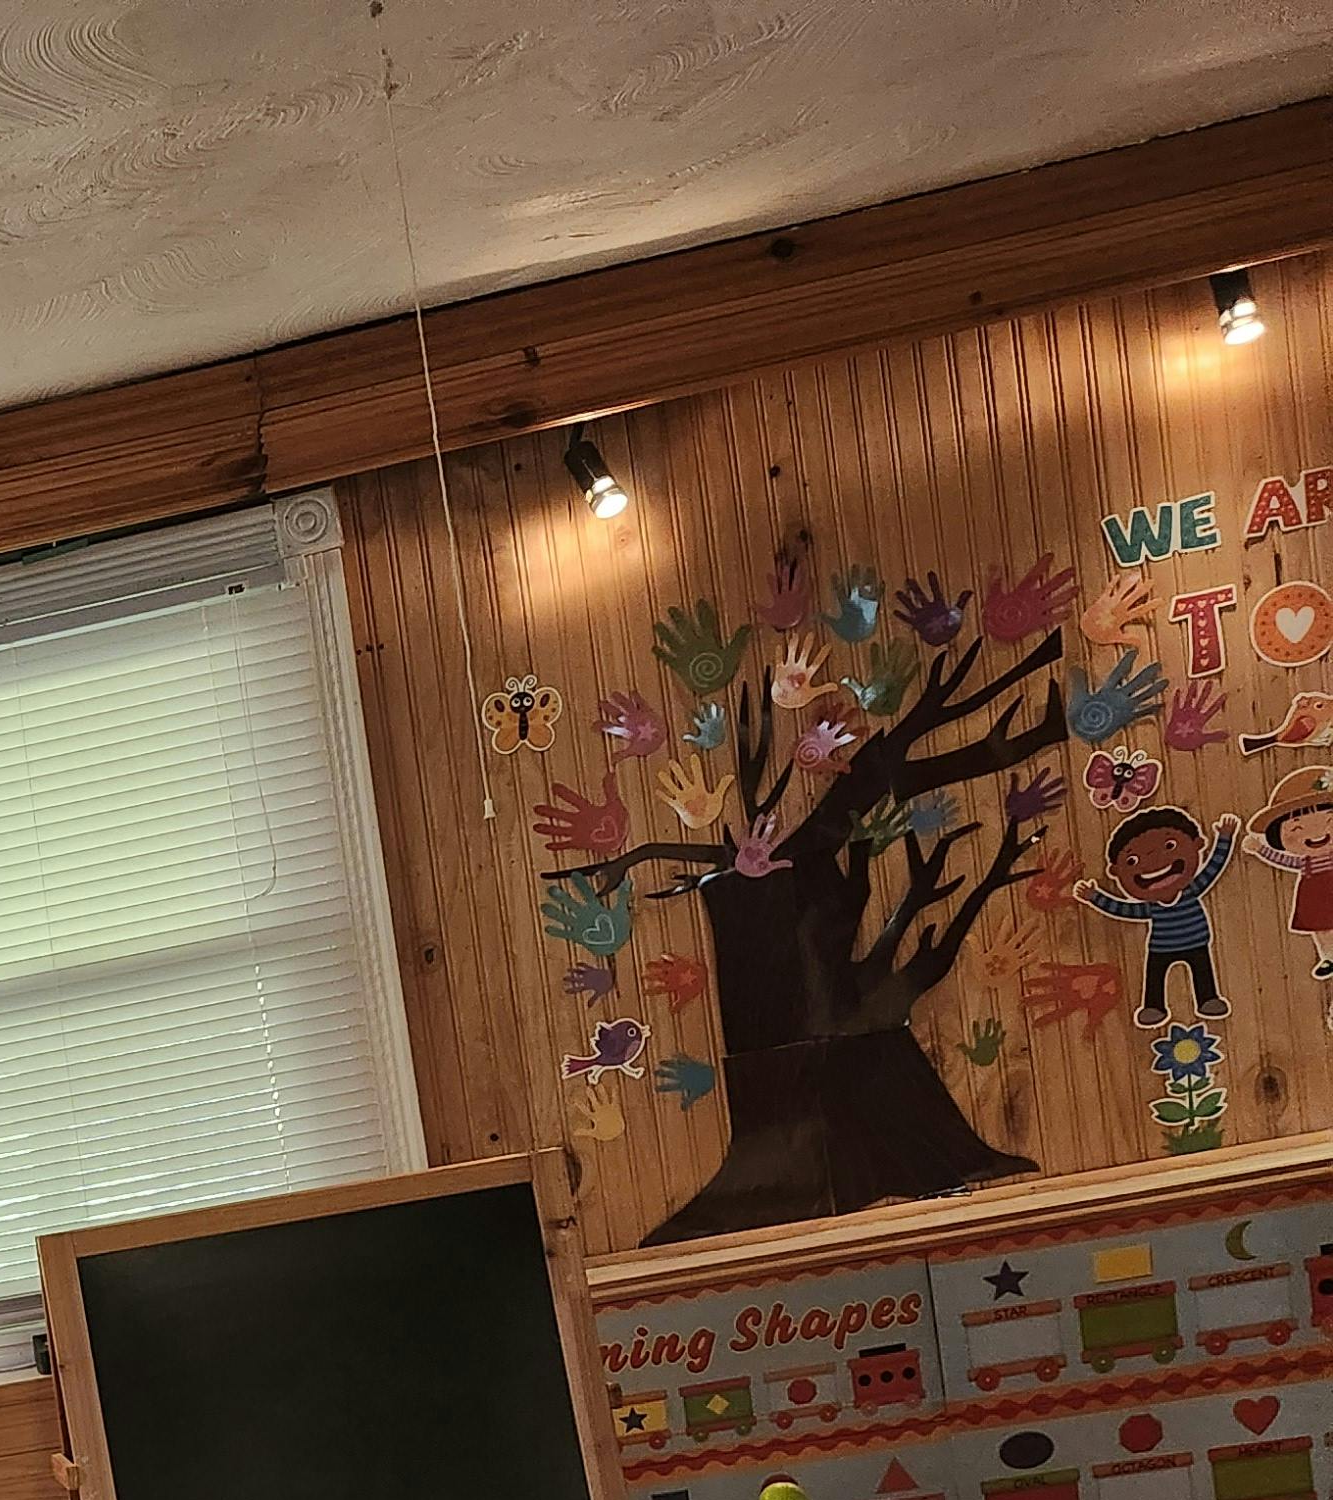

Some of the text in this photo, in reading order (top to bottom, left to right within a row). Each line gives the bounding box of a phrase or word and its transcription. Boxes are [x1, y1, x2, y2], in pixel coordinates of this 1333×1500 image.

[1102, 467, 1333, 567] WE AR
[1207, 1266, 1276, 1288] CRESCENT
[729, 1292, 923, 1352] Shapes
[992, 1305, 1028, 1321] STAR
